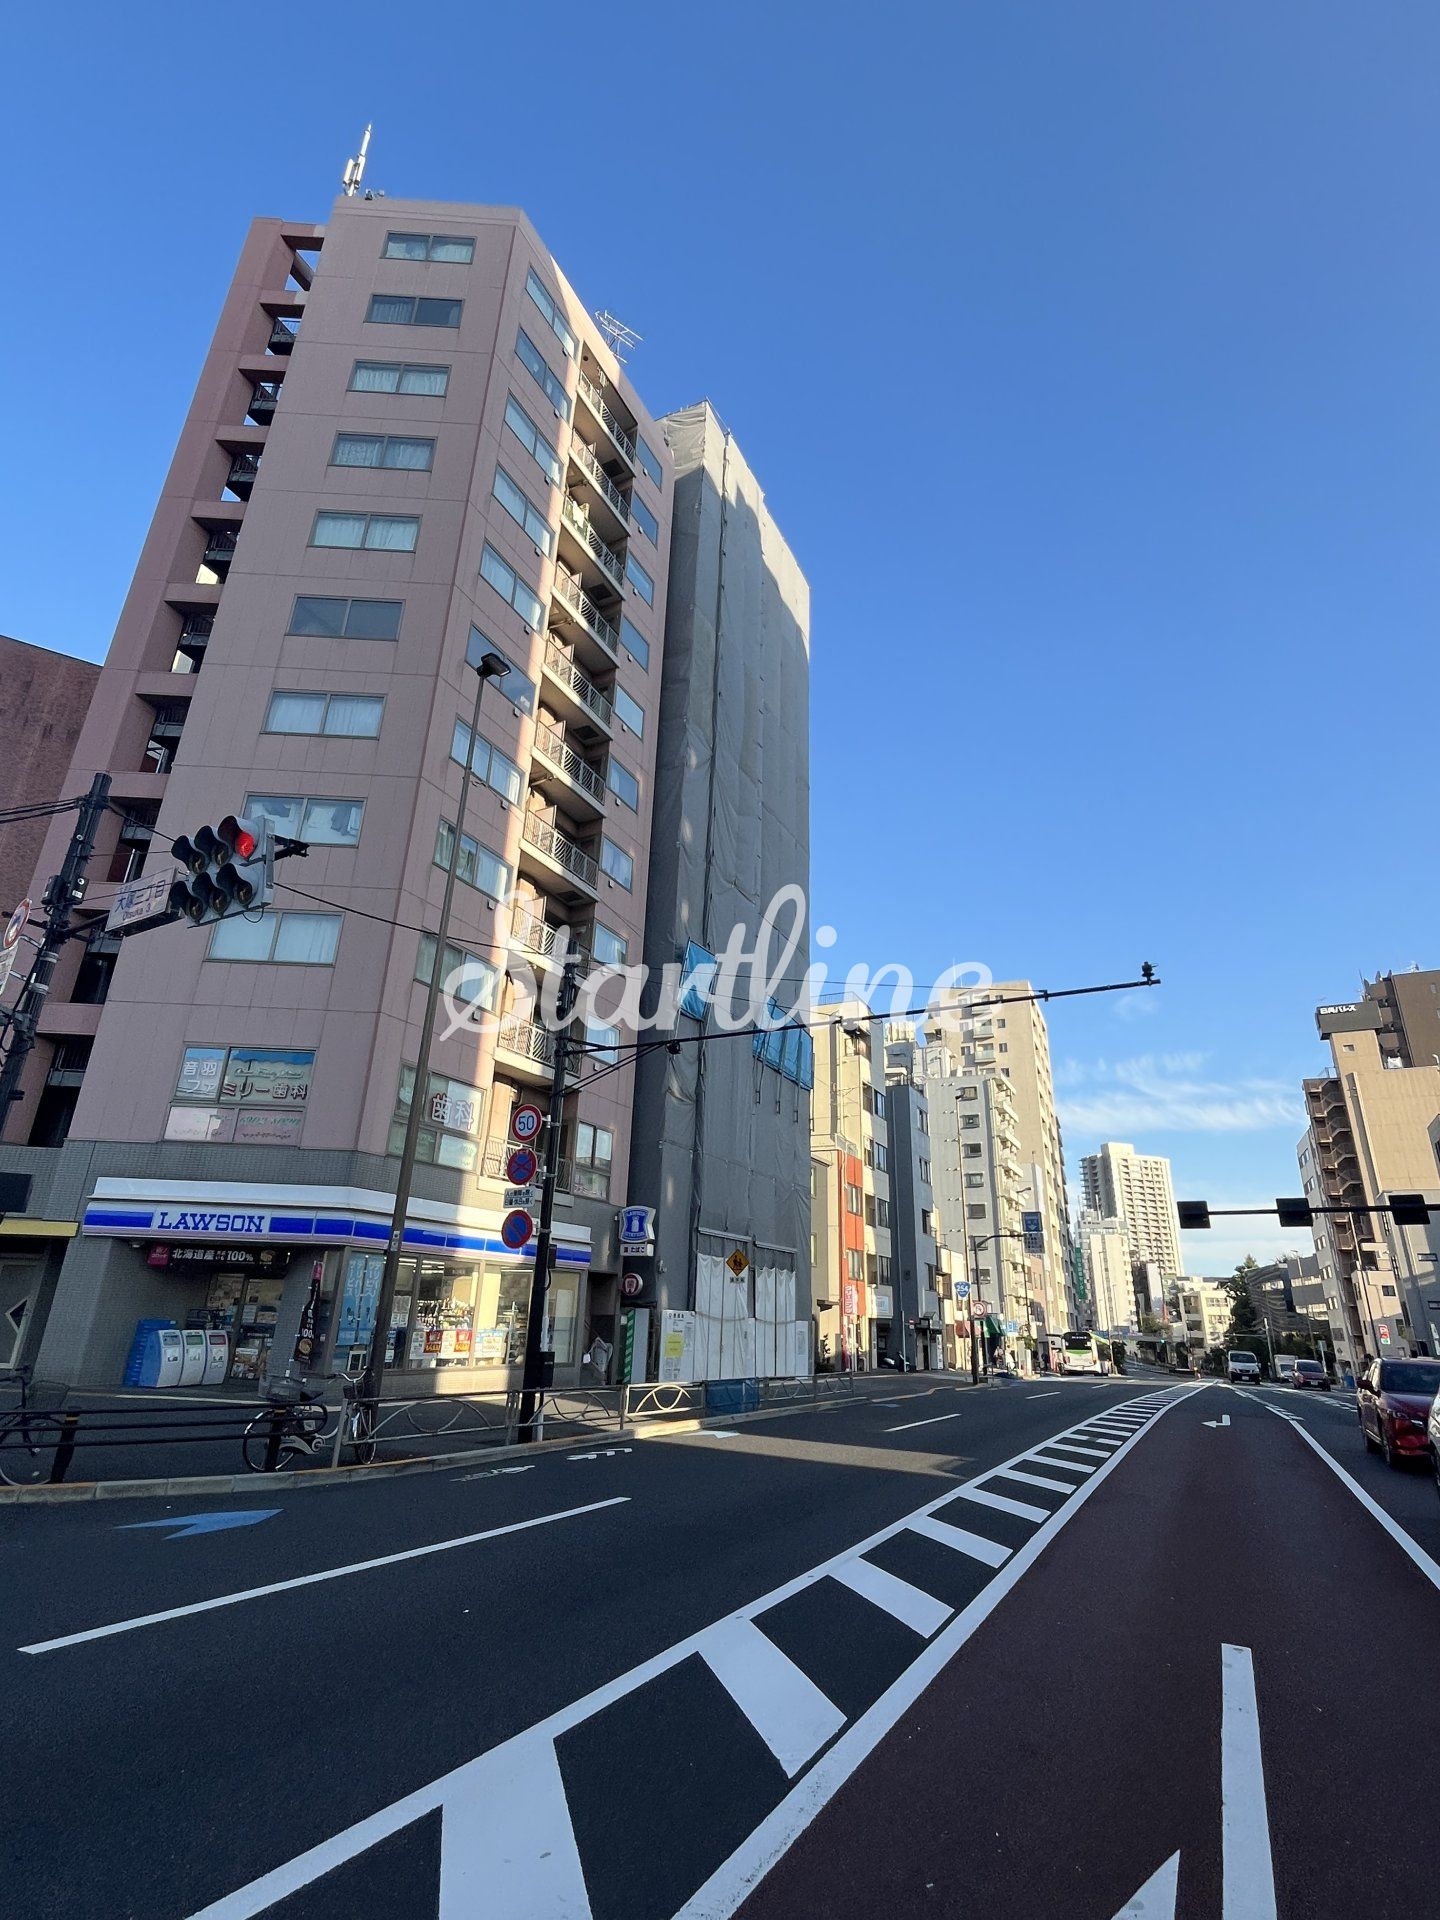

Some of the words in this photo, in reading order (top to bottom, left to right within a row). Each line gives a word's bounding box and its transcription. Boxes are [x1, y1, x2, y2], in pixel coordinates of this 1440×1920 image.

[183, 1061, 218, 1077] 音羽
[431, 1093, 474, 1131] 歯科
[517, 1115, 536, 1132] 50
[157, 1211, 265, 1232] LAWSON
[956, 1284, 969, 1292] 254
